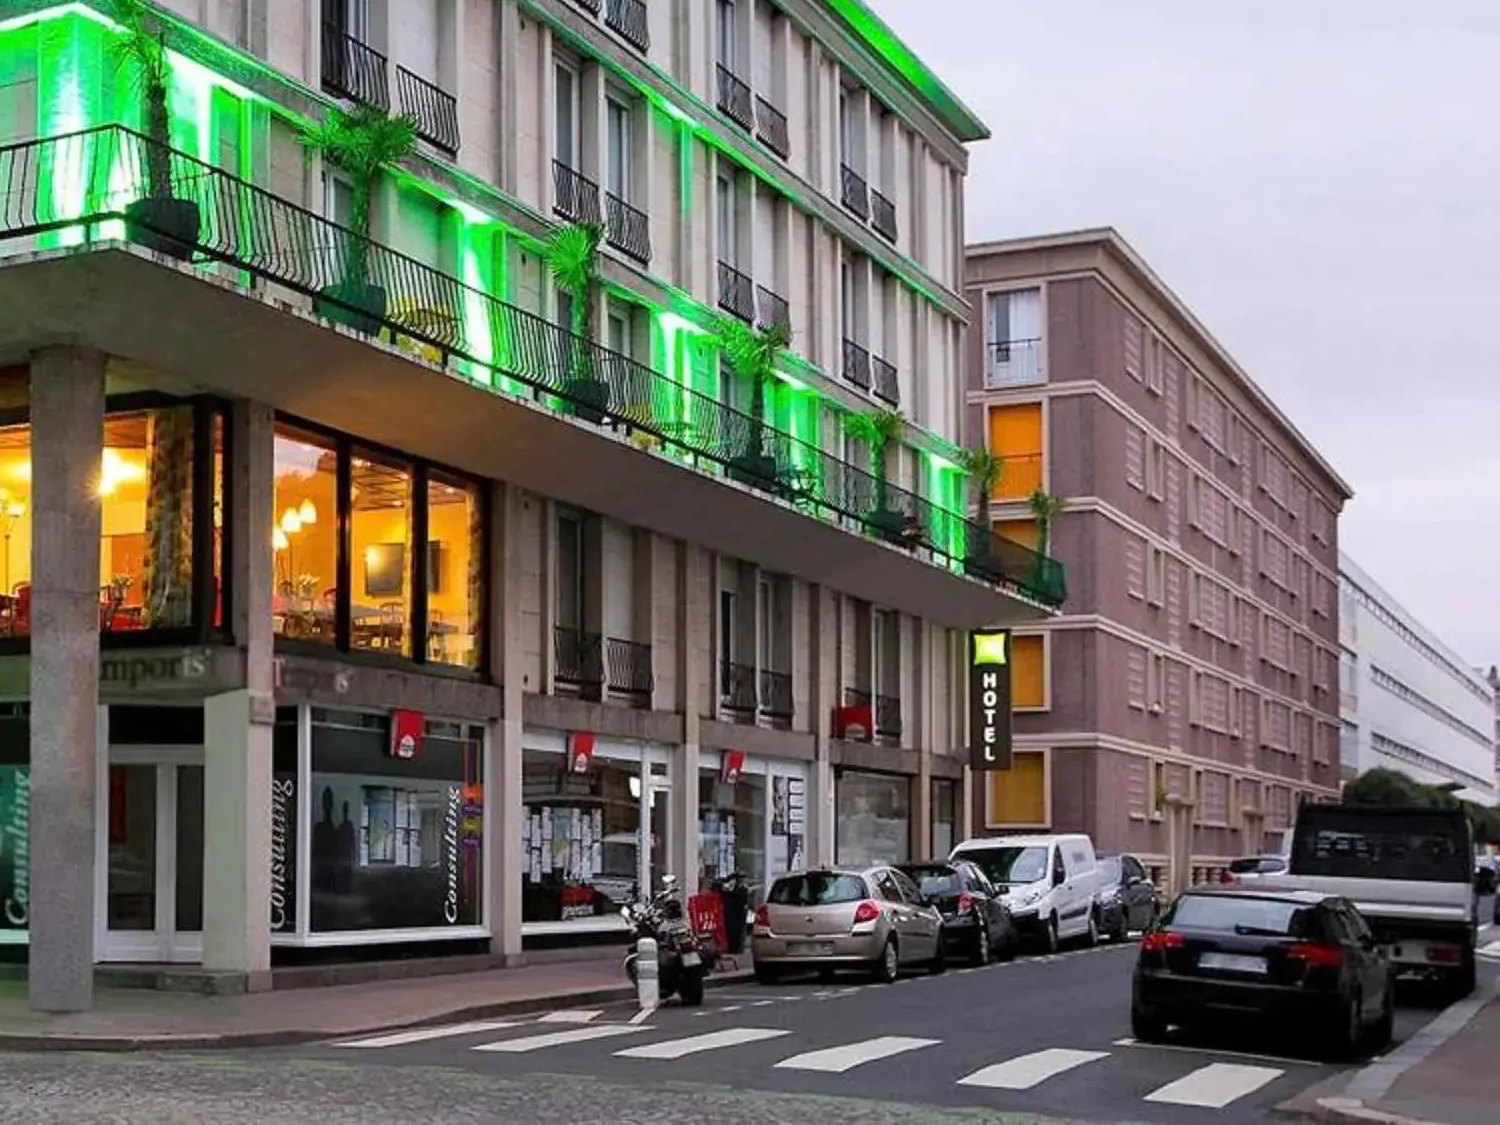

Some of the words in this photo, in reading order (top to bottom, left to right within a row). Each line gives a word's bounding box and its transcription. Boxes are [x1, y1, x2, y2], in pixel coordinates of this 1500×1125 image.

[982, 672, 997, 762] HOTEL
[4, 769, 30, 925] Consulting
[443, 785, 461, 924] Consulting
